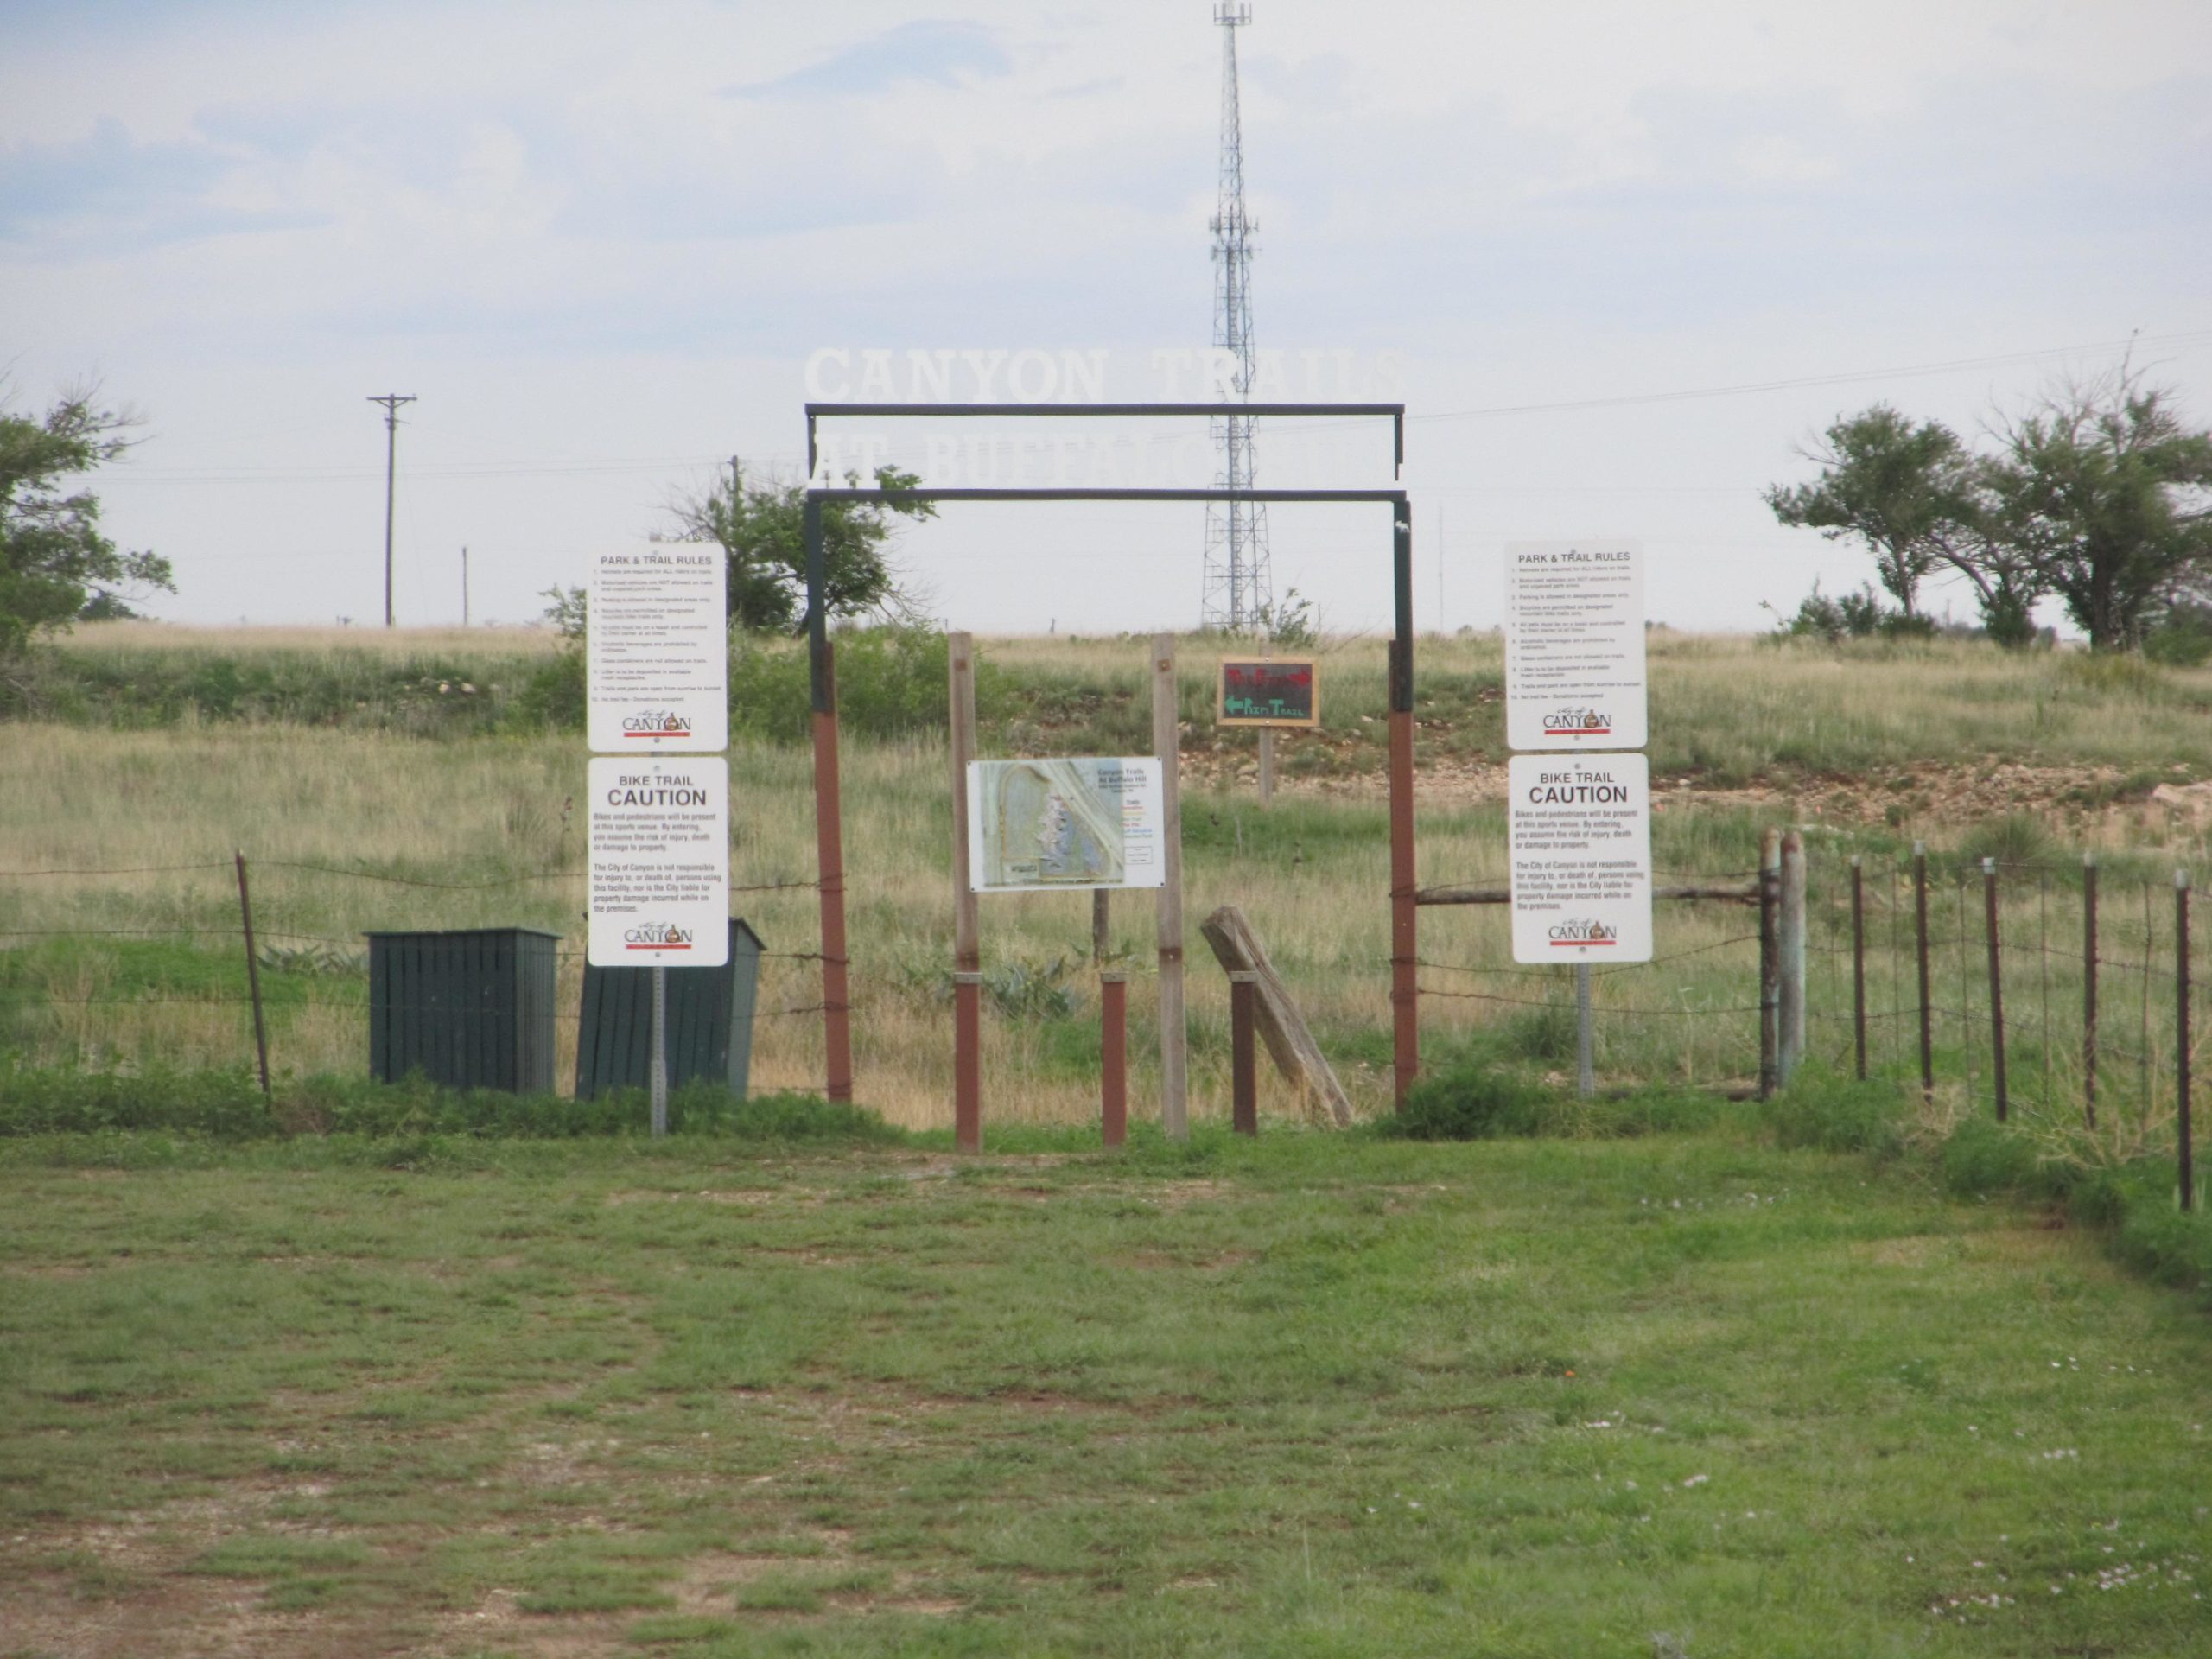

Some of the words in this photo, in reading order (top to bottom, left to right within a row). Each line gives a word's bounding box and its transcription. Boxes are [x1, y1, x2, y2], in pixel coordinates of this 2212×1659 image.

[804, 347, 1109, 402] CANYON
[1152, 348, 1405, 402] TRAILS
[809, 434, 888, 487] AT
[601, 556, 630, 565] PARK
[634, 556, 639, 565] &
[644, 556, 673, 564] TRAIL
[677, 556, 712, 564] RULES
[1518, 554, 1547, 563] PARK
[1551, 554, 1558, 562] &
[1562, 553, 1592, 562] TRAIL
[1595, 552, 1630, 561] RULES
[622, 717, 691, 731] CANYON
[1543, 714, 1611, 728] CANYON
[619, 776, 650, 786] BIKE
[654, 776, 693, 786] TRAIL
[1541, 773, 1571, 783] BIKE
[1576, 772, 1614, 783] TRAIL
[608, 789, 706, 806] CAUTION
[1529, 786, 1627, 803] CAUTION
[626, 813, 665, 822] pedestrians
[691, 813, 716, 822] present
[1548, 811, 1587, 819] pedestrians
[1612, 810, 1638, 818] present
[615, 823, 635, 831] sports
[1537, 821, 1557, 829] sports
[602, 843, 628, 852] damage
[1524, 842, 1550, 850] damage
[607, 864, 620, 872] City
[629, 864, 654, 872] Canyon
[676, 864, 714, 872] responsible
[1530, 862, 1542, 870] City
[1552, 861, 1577, 870] Canyon
[1598, 861, 1637, 869] responsible
[604, 874, 623, 882] injury
[703, 874, 721, 882] using
[1527, 872, 1546, 881] injury
[666, 884, 678, 892] City
[1589, 882, 1601, 890] City
[594, 894, 620, 903] property
[623, 894, 649, 903] damage
[1517, 893, 1544, 901] property
[1546, 893, 1572, 901] damage
[624, 929, 693, 943] CANYON
[1549, 926, 1617, 940] CANYON
